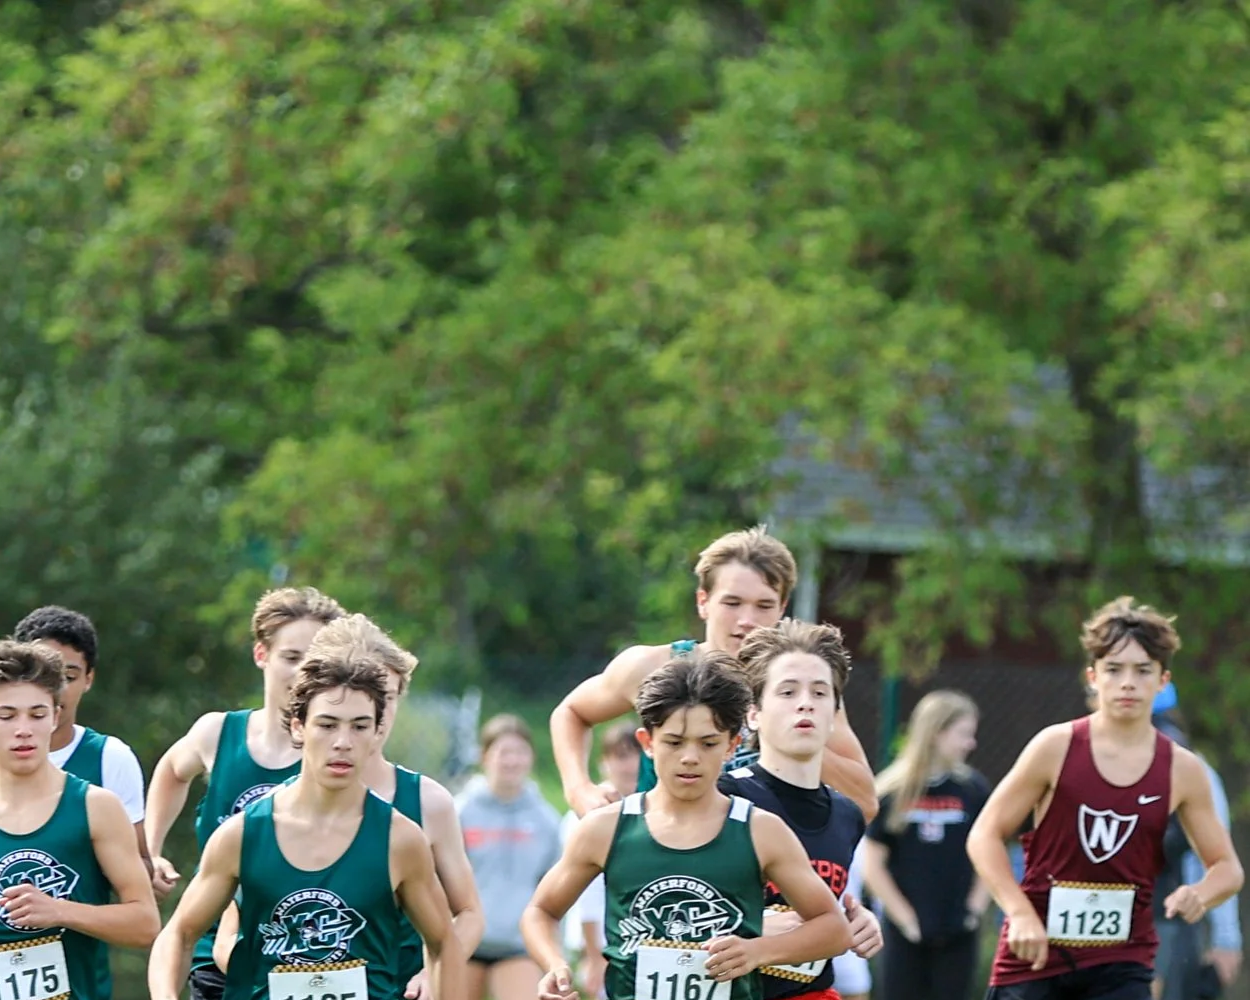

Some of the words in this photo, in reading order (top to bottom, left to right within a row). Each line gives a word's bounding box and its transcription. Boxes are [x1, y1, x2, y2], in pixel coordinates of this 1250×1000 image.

[1087, 815, 1121, 852] N
[274, 891, 342, 917] WATERFORD
[634, 879, 716, 910] WATERFORD
[1058, 910, 1121, 936] 1123
